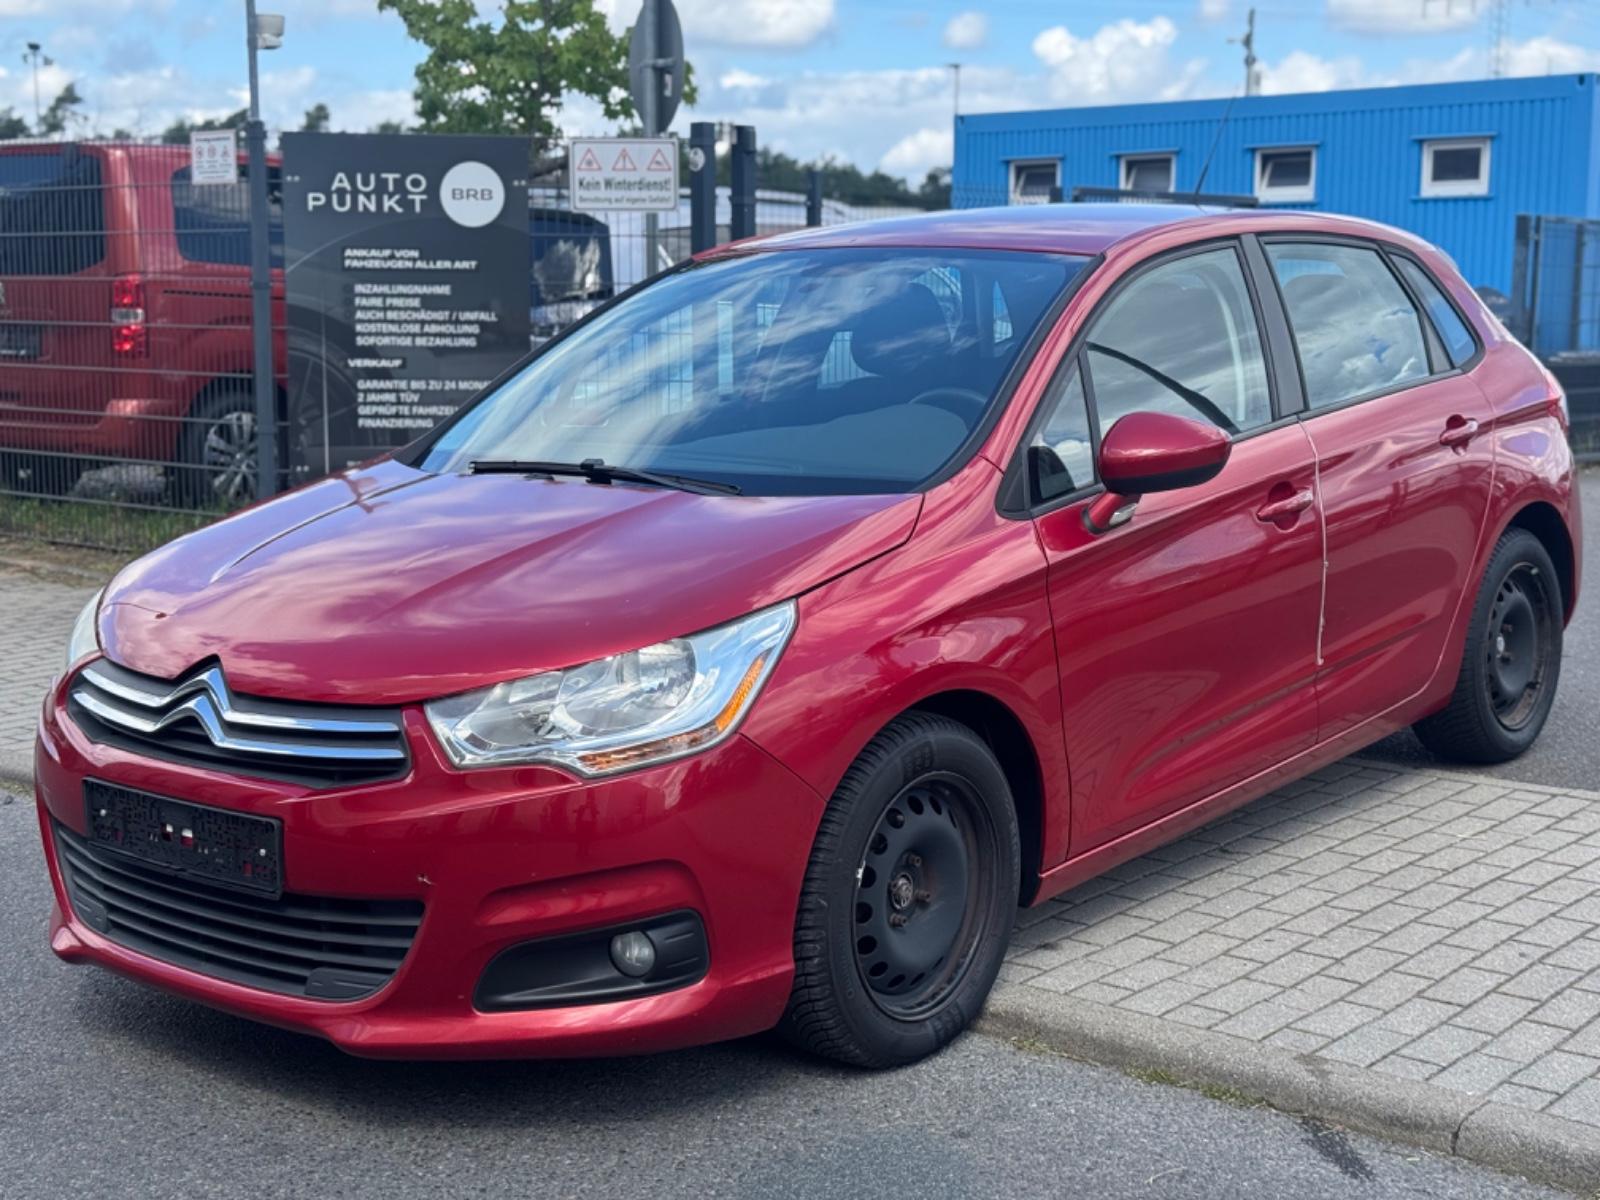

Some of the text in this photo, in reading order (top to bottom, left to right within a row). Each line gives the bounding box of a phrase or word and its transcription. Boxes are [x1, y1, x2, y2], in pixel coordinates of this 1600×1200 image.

[331, 172, 428, 193] AUTO
[578, 176, 601, 191] Kein
[451, 188, 494, 201] BRB
[306, 192, 428, 213] PUNKT
[344, 248, 420, 258] ANKAUF VON
[414, 260, 452, 269] ALLER
[452, 260, 478, 270] ART
[354, 284, 452, 295] INZAHLUNGNAHME
[355, 297, 421, 308] FAIRE PREISE
[355, 310, 384, 320] AUCH
[386, 309, 450, 321] BESCHÄDIGT
[458, 312, 498, 321] UNFALL
[355, 323, 480, 334] KOSTENLOSE ABHOLUNG
[356, 336, 477, 347] SOFORTIGE BEZAHLUNG
[347, 358, 403, 367] VERKAUF
[357, 380, 492, 390] GARANTIE BIS ZU 24 MONA
[357, 390, 421, 403] 2 JAHRE TÜV
[357, 404, 410, 415] GEPRÜFTE
[358, 417, 435, 428] FINANZIERUNG
